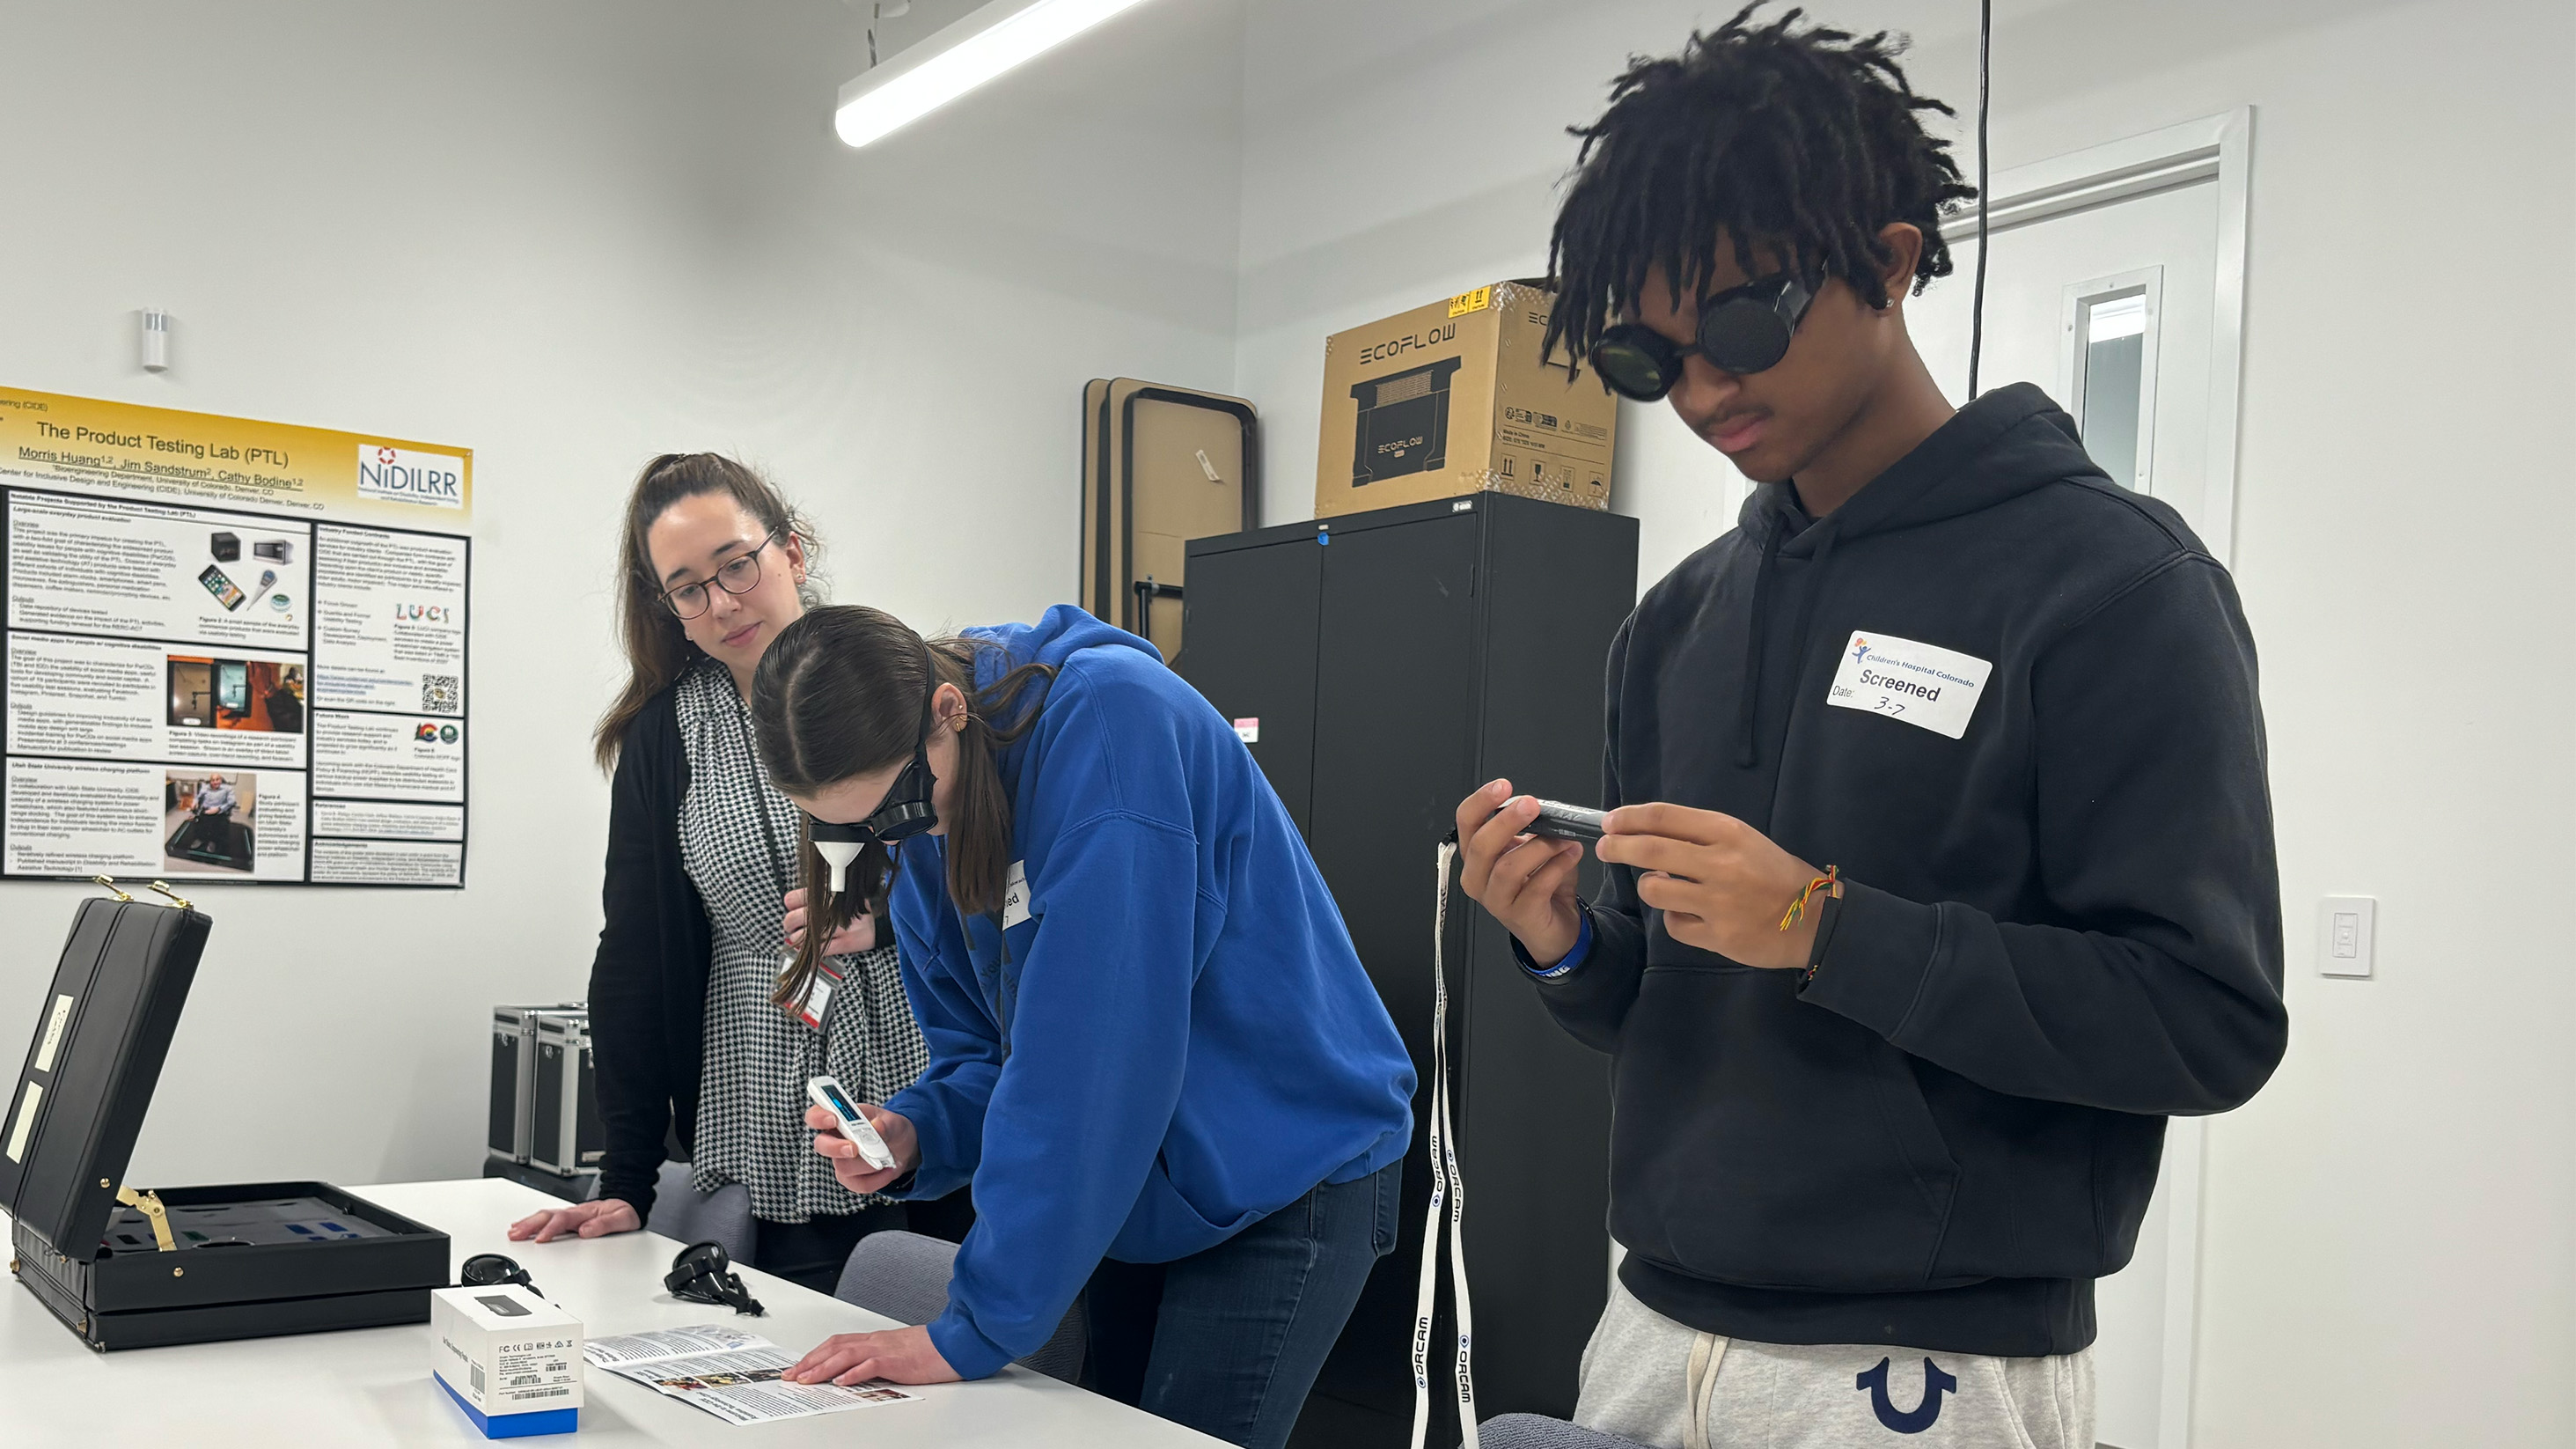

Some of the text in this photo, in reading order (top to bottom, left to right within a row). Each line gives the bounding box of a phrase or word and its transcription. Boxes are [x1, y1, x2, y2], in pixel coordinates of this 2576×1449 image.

[1360, 323, 1456, 364] ECOFLOW
[19, 445, 57, 461] Morris
[120, 459, 141, 470] Jim
[218, 470, 252, 484] Cathy
[37, 421, 289, 468] The Product Testing Lab (PTL)
[1377, 436, 1423, 454] ECOFLOW
[1860, 669, 1941, 702] Screened
[1867, 654, 1975, 688] Children's Hospital Colorado
[1832, 685, 1854, 698] Date:
[1874, 696, 1905, 716] 3-7
[1431, 1136, 1443, 1192] ORCAM
[1450, 1164, 1463, 1223] ORCAM
[1416, 1317, 1428, 1375] ORCAM
[1457, 1350, 1471, 1403] ORCAM
